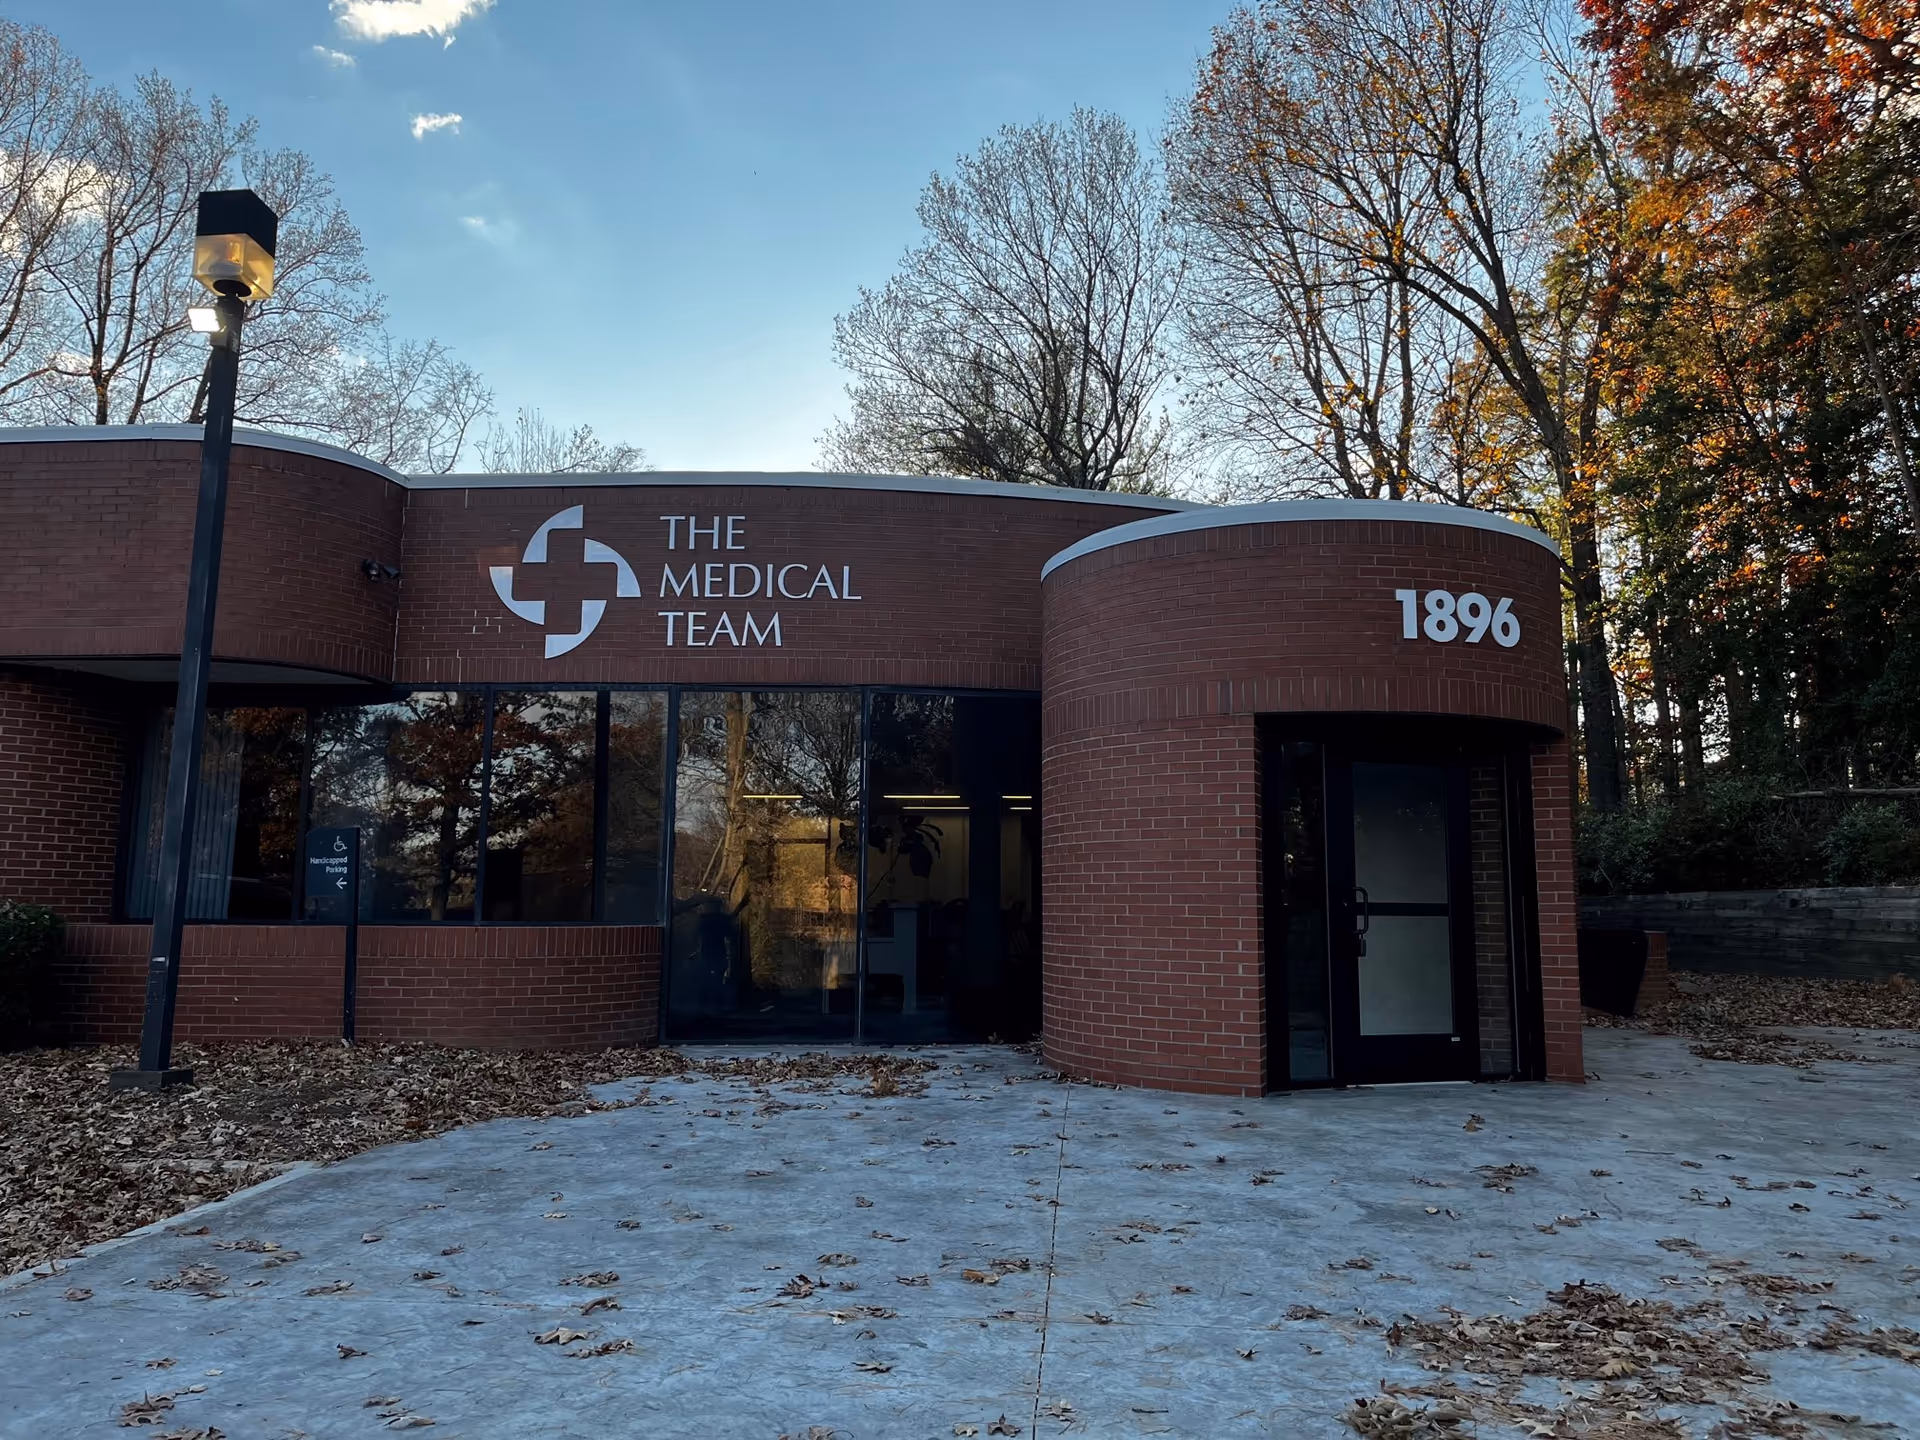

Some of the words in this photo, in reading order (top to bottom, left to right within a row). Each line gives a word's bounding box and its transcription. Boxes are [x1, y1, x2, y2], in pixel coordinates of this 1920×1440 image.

[659, 515, 746, 550] THE
[659, 562, 862, 600] MEDICAL
[657, 610, 782, 647] TEAM
[1395, 588, 1521, 648] 1896
[309, 856, 348, 865] Handicapped
[325, 866, 348, 874] Parking
